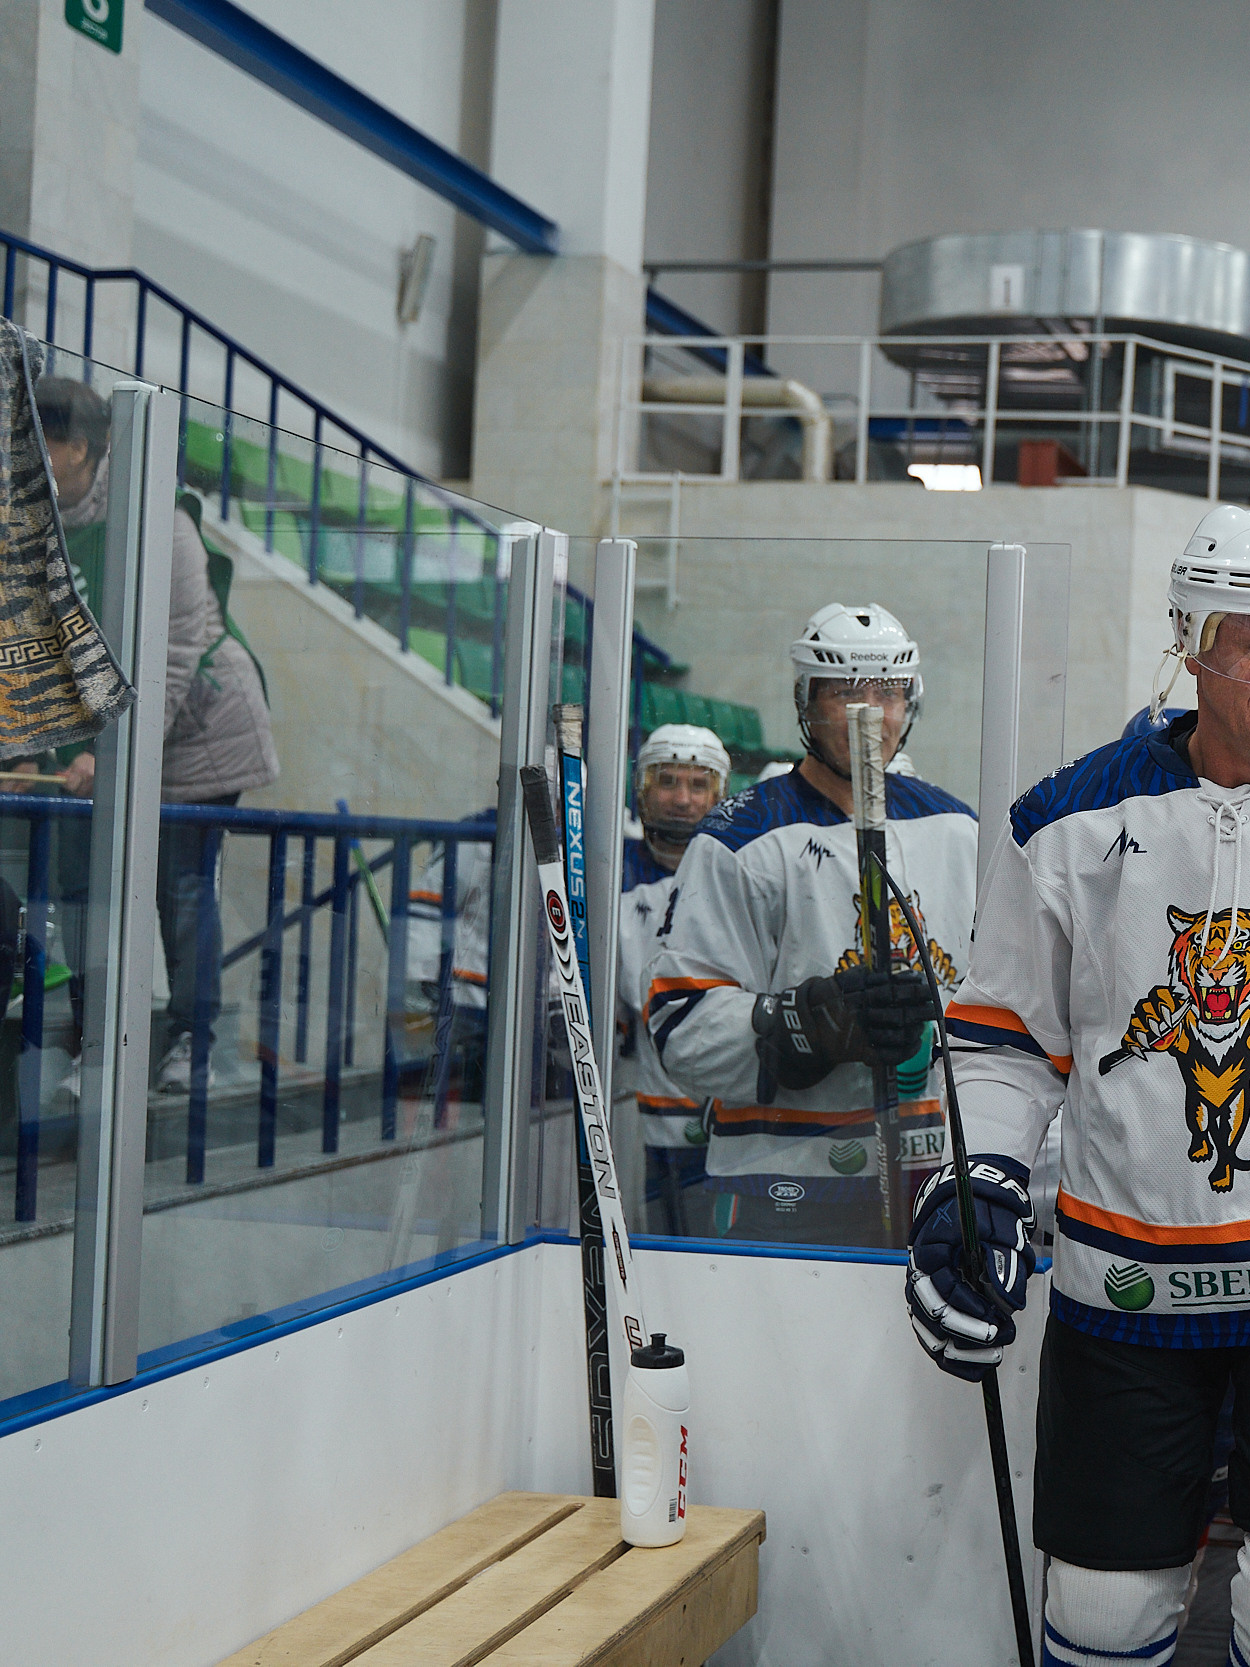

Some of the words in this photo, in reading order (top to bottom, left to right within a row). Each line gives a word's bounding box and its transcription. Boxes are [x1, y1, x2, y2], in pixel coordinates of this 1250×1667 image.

[850, 652, 889, 662] Reebok
[567, 781, 585, 898] NEXUS
[563, 991, 617, 1200] EASTON
[579, 1166, 614, 1471] NEXUS
[677, 1425, 689, 1520] CCM
